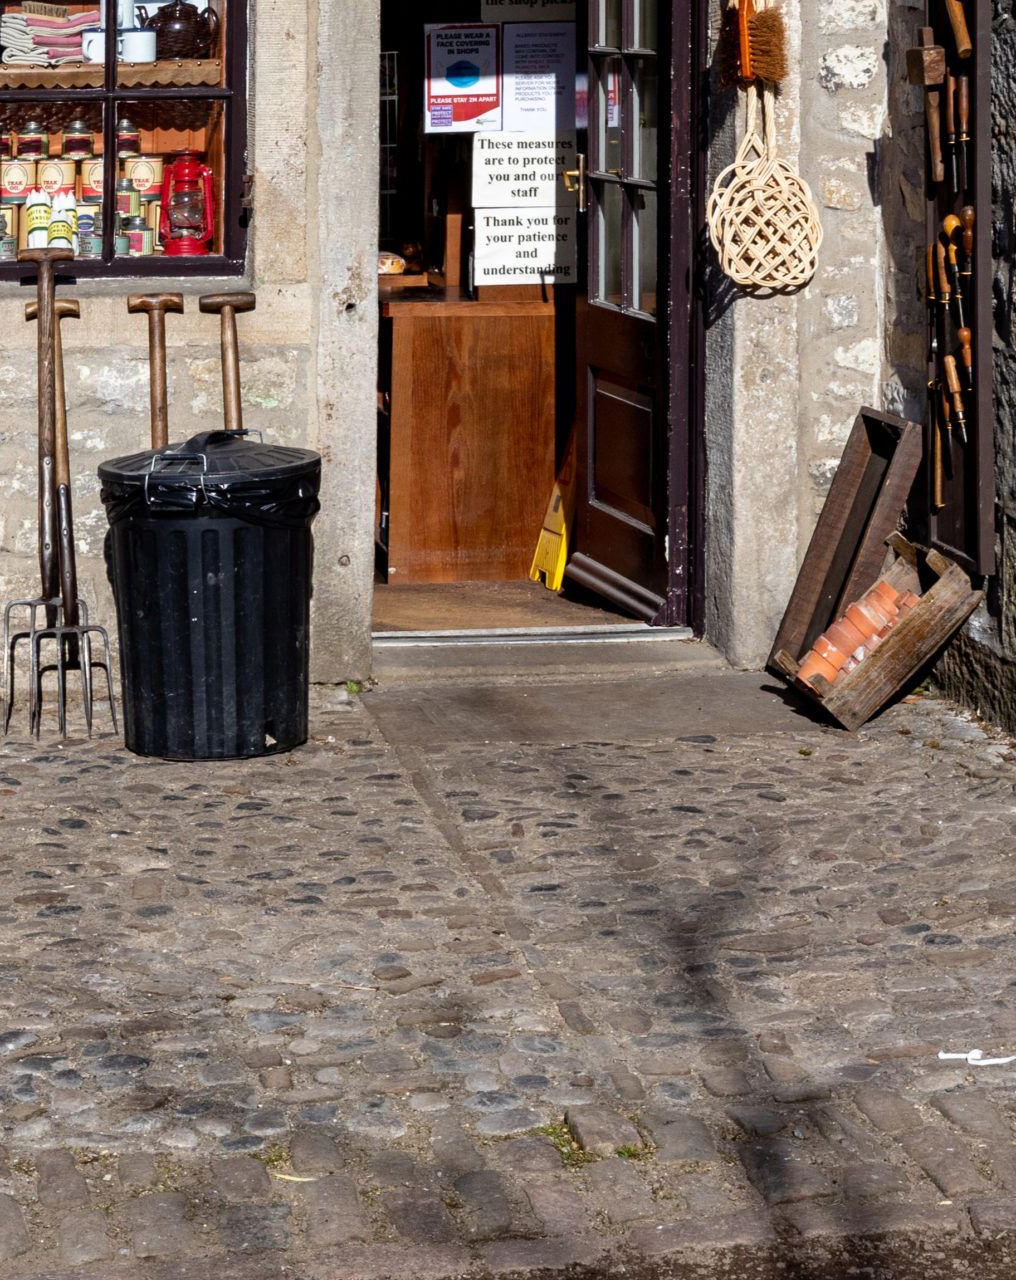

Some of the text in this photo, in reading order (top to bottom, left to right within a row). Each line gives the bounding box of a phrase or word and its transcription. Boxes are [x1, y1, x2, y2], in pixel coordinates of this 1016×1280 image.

[436, 40, 453, 48] FACE
[478, 139, 572, 149] These measures
[484, 155, 566, 167] are to protect
[488, 171, 562, 184] you and our
[511, 186, 539, 197] staff
[483, 215, 570, 228] Thank you for
[486, 232, 568, 245] your patience
[515, 248, 538, 258] and
[483, 264, 571, 276] understanding
